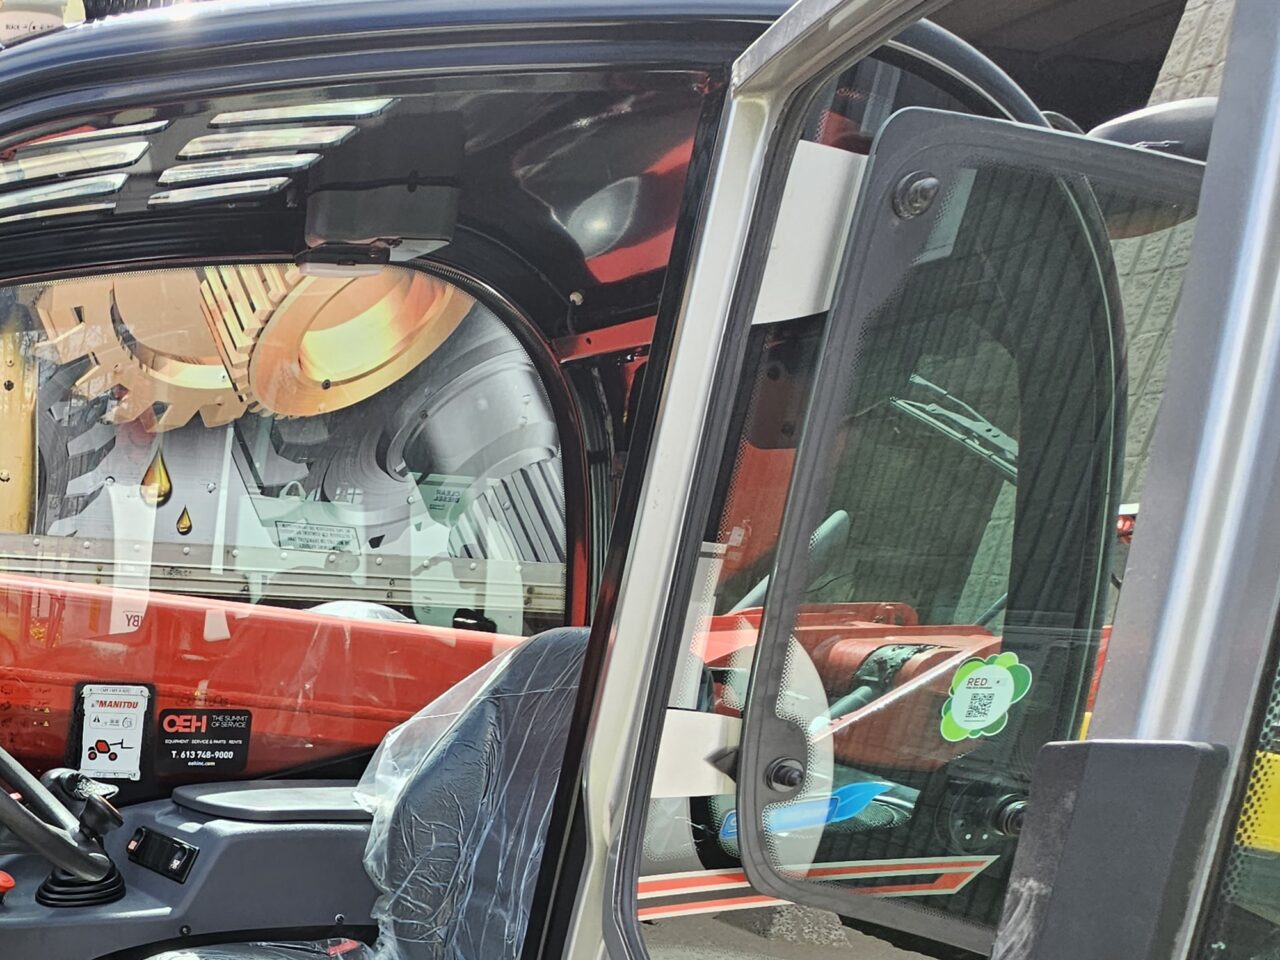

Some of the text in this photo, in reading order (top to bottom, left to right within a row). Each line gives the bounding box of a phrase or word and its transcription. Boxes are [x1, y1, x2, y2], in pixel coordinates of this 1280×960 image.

[97, 700, 139, 709] MANITOU
[163, 714, 208, 733] OEH
[171, 750, 234, 759] T. 613 748-9000
